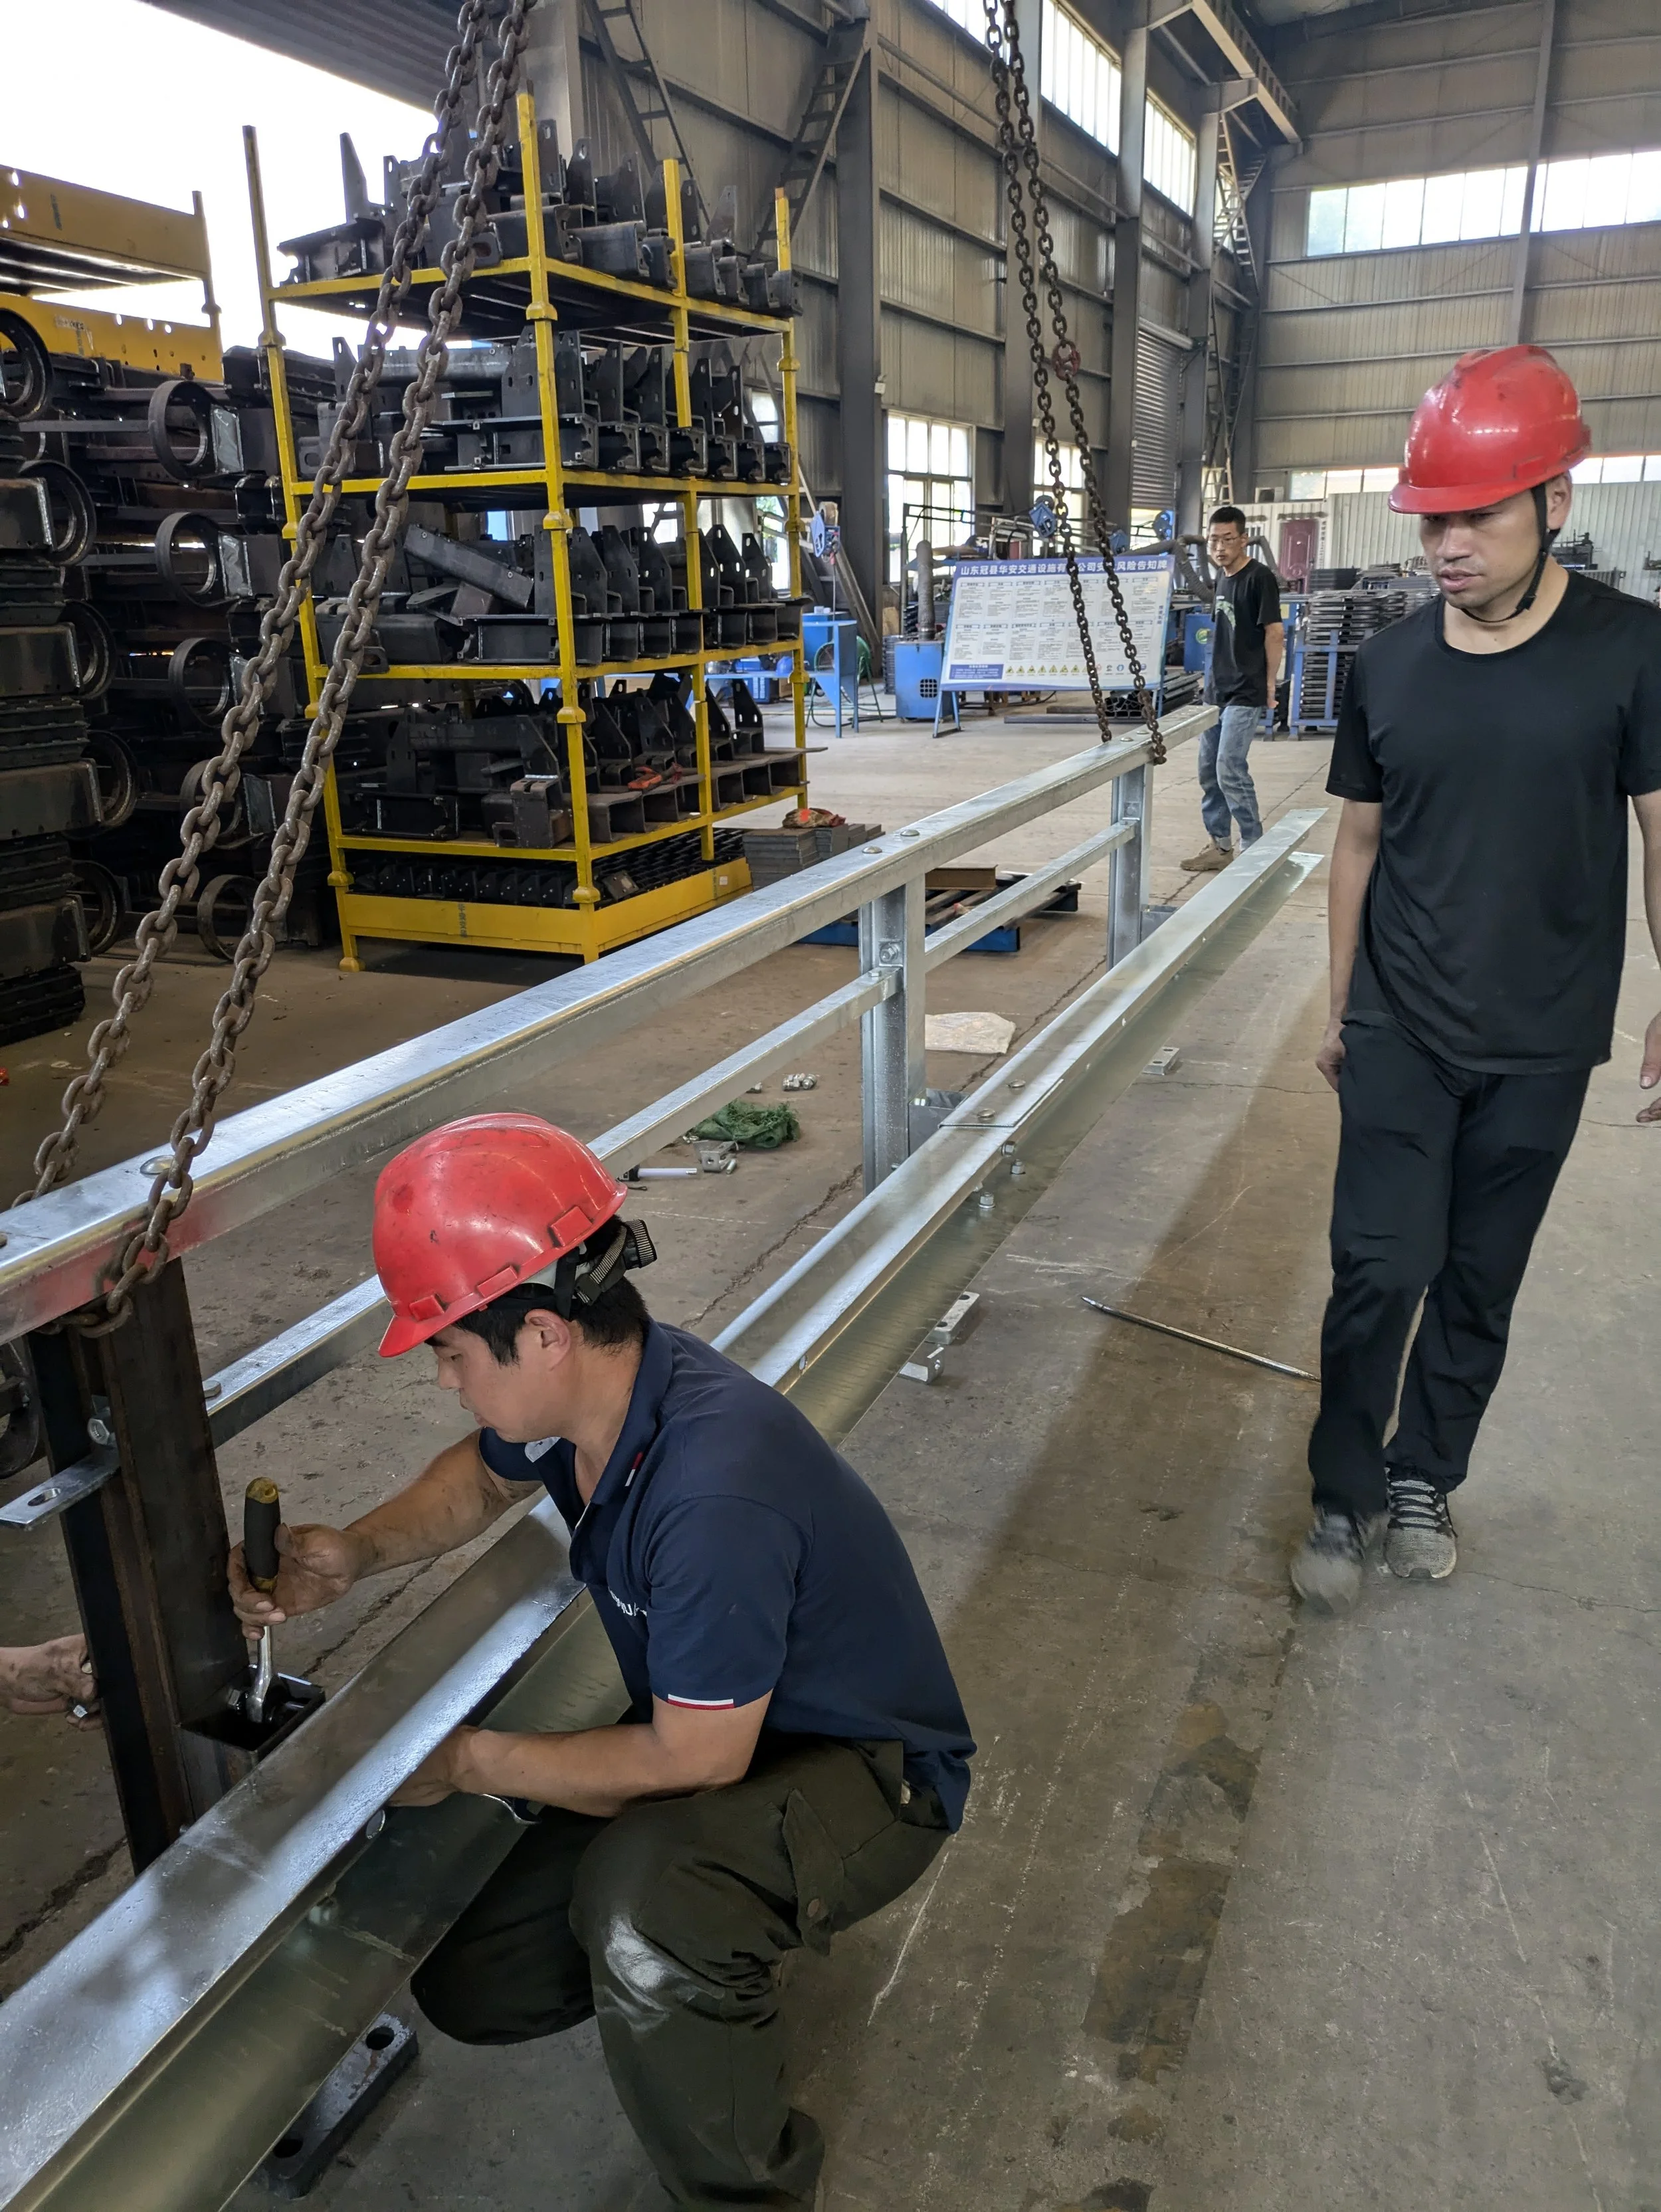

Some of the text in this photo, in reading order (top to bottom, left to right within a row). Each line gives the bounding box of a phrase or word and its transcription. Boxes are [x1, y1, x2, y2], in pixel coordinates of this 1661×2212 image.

[961, 559, 1167, 575] 山东冠县华安交通设施有公司安风险告知牌
